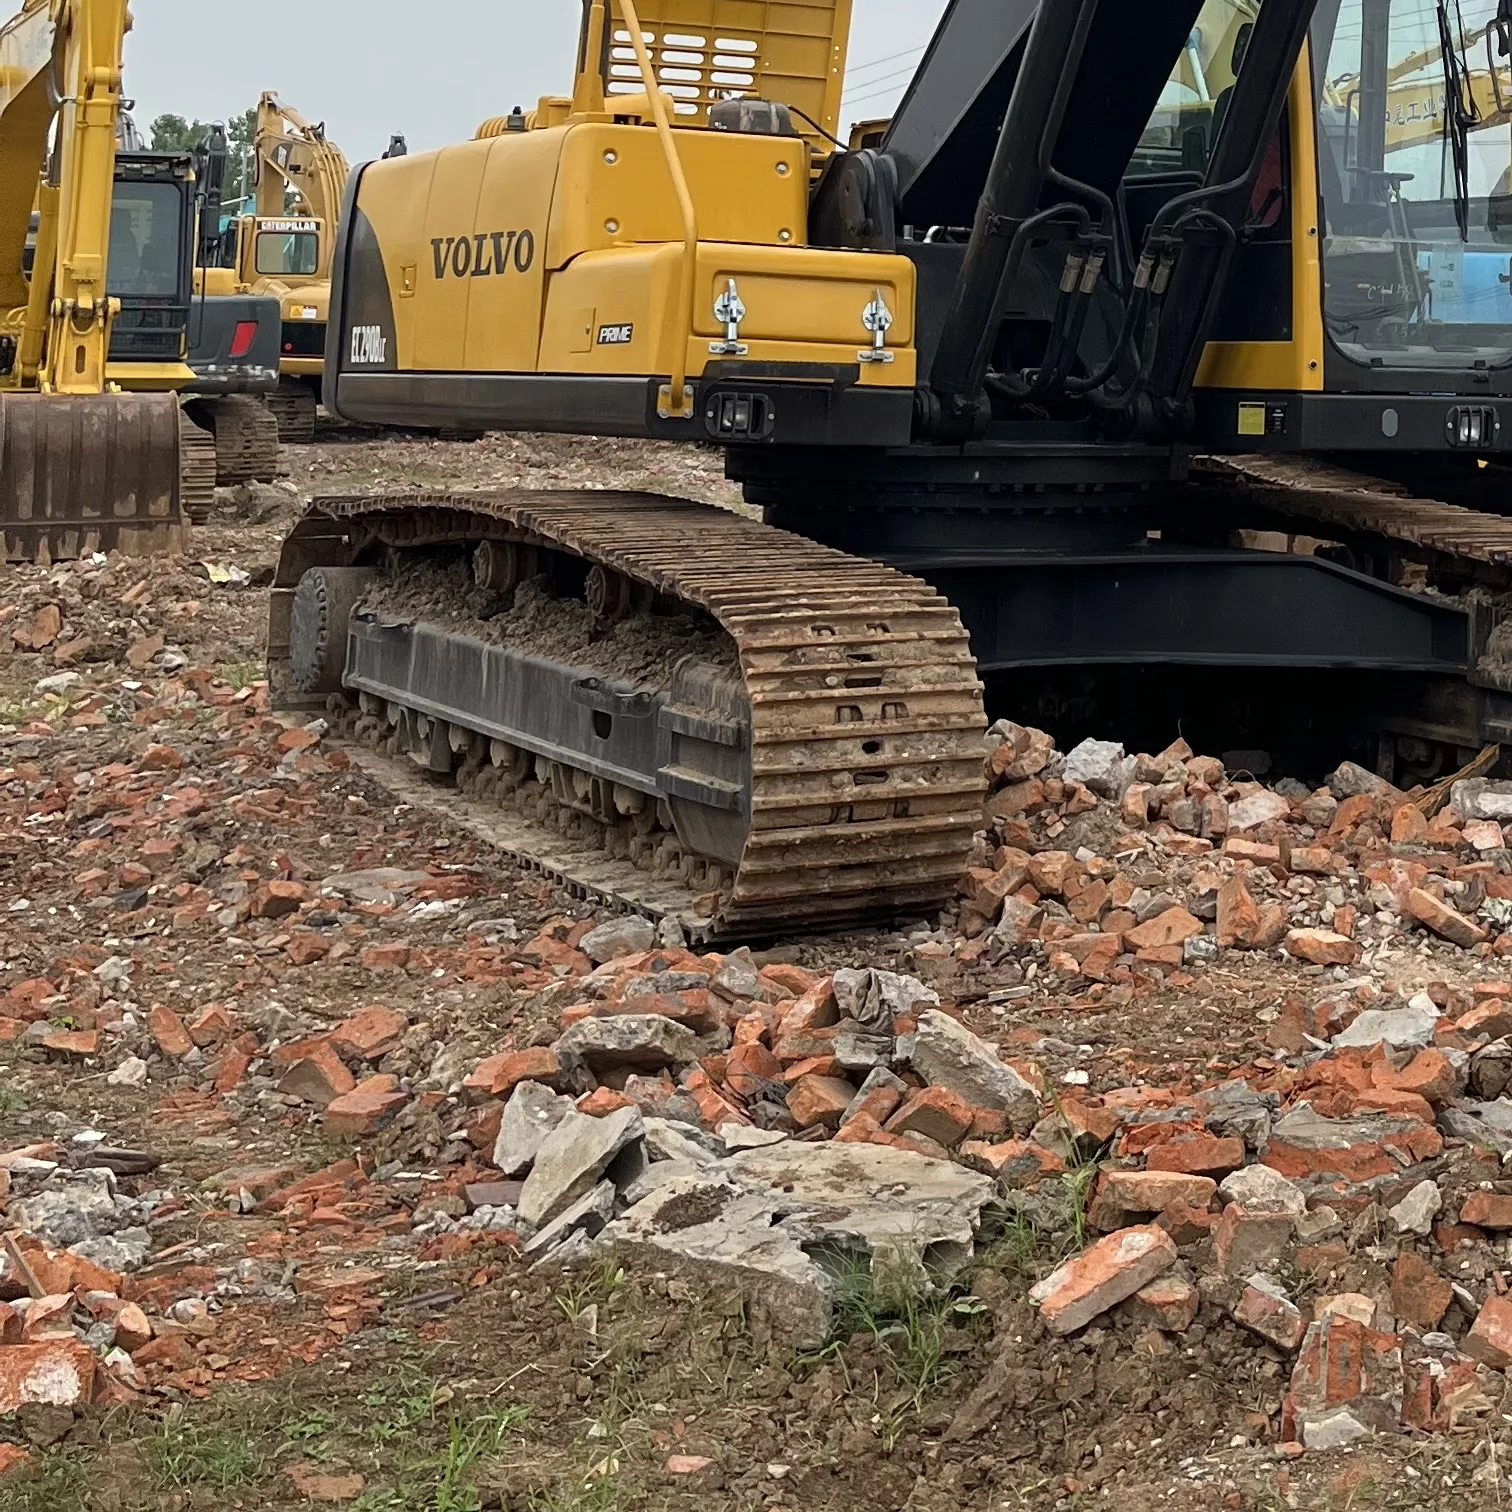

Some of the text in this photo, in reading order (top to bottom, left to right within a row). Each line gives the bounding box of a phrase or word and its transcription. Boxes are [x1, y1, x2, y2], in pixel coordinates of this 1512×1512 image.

[261, 221, 317, 231] CATERPILLAR
[430, 229, 535, 279] VOLVO
[598, 325, 633, 343] PRIME
